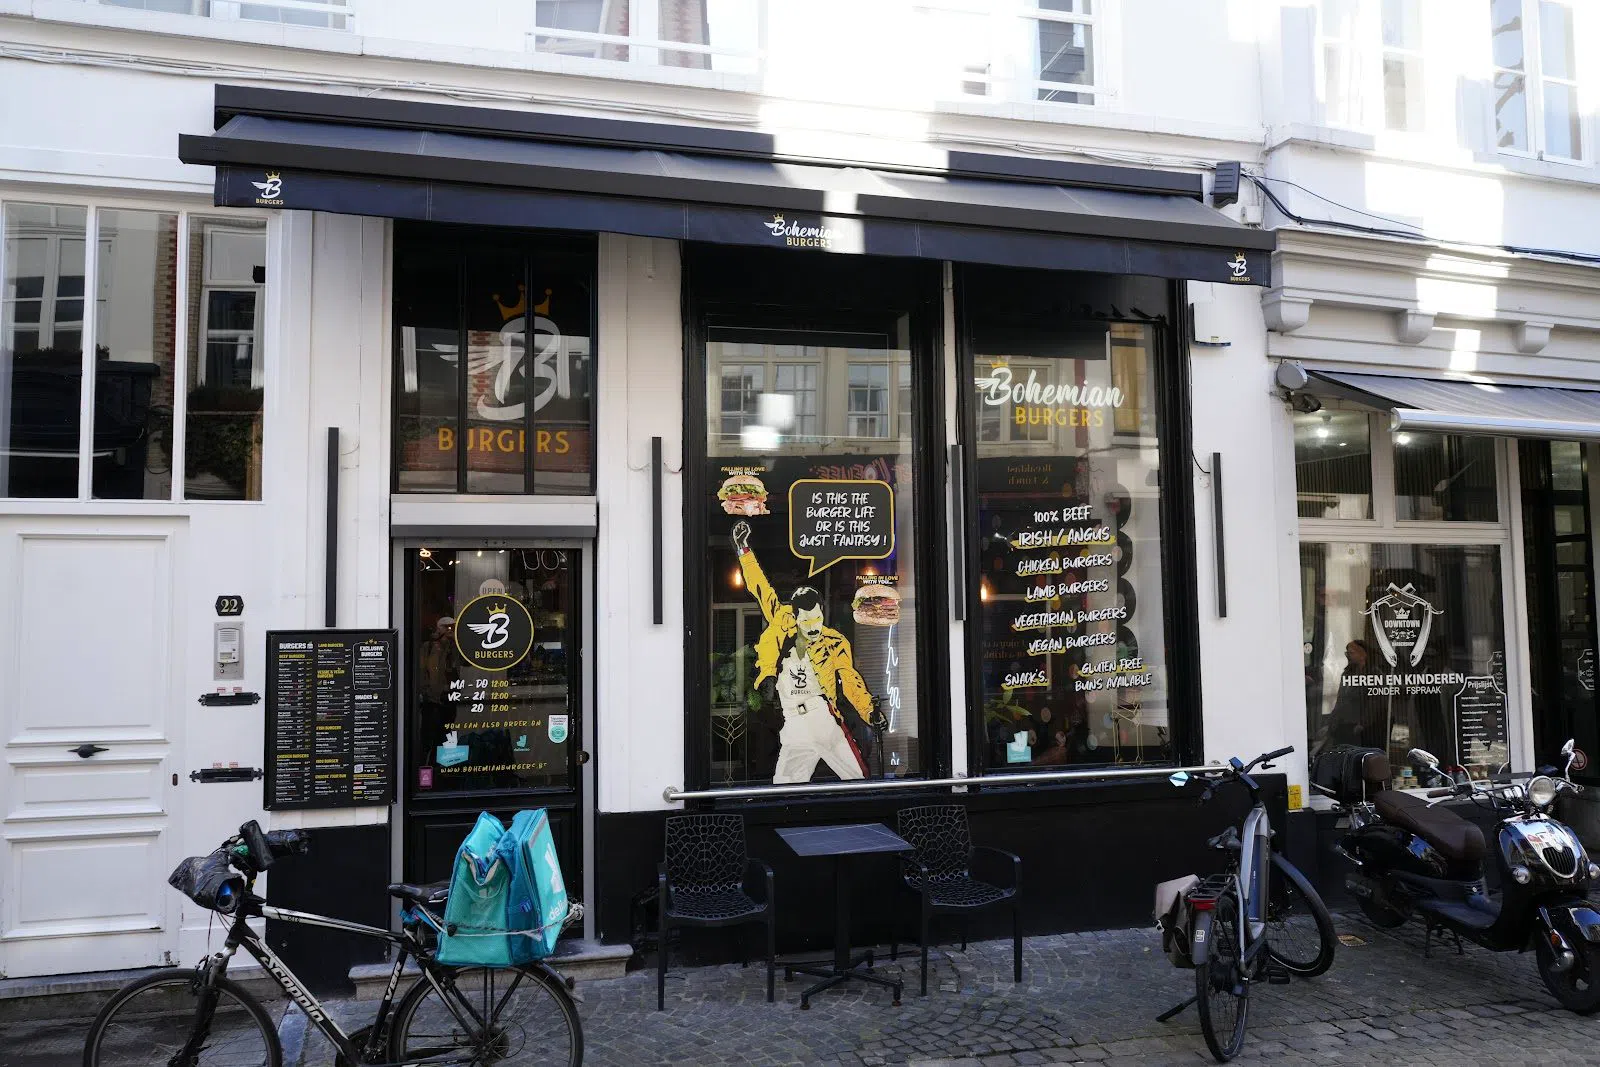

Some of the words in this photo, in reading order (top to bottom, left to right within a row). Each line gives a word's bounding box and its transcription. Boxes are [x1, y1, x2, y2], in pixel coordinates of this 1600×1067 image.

[786, 236, 834, 249] BURGERS
[984, 367, 1125, 408] Bohemian
[1015, 406, 1104, 427] BURGERS
[812, 493, 822, 505] IS
[826, 492, 847, 505] THIS
[849, 492, 870, 505] THE
[807, 507, 852, 518] BURGER
[855, 507, 876, 518] LIFE
[1033, 511, 1060, 523] 100%
[1062, 505, 1092, 522] BEEF
[816, 521, 831, 532] OR
[835, 521, 845, 532] IS
[848, 521, 870, 532] THIS
[799, 535, 831, 547] JUST
[833, 534, 880, 547] FANTASY
[1018, 530, 1053, 546] IRISH
[1067, 527, 1110, 545] ANGUS
[1018, 560, 1060, 574] CHICKEN
[1062, 554, 1114, 568] BURGERS
[1026, 584, 1057, 600] LAMB
[1059, 580, 1109, 596] BURGERS
[220, 599, 239, 613] 22
[1014, 610, 1075, 628] VEGETARIAN
[1077, 607, 1128, 623] BURGERS
[1384, 620, 1420, 628] DOWNTOWN
[1028, 637, 1064, 654] VEGAN
[1065, 632, 1116, 650] BURGERS
[474, 651, 514, 659] BURGERS
[1082, 660, 1117, 675] GLUTEN
[1119, 658, 1143, 670] FREE
[450, 679, 465, 690] MA
[1075, 678, 1103, 692] BUNS
[1106, 673, 1152, 690] AVAILABLE
[1342, 675, 1382, 687] HEREN
[1386, 675, 1402, 686] EN
[1405, 673, 1464, 685] KINDEREN
[1468, 682, 1494, 690] Prijslijst
[448, 692, 462, 702] VR
[1368, 687, 1400, 696] ZONDER
